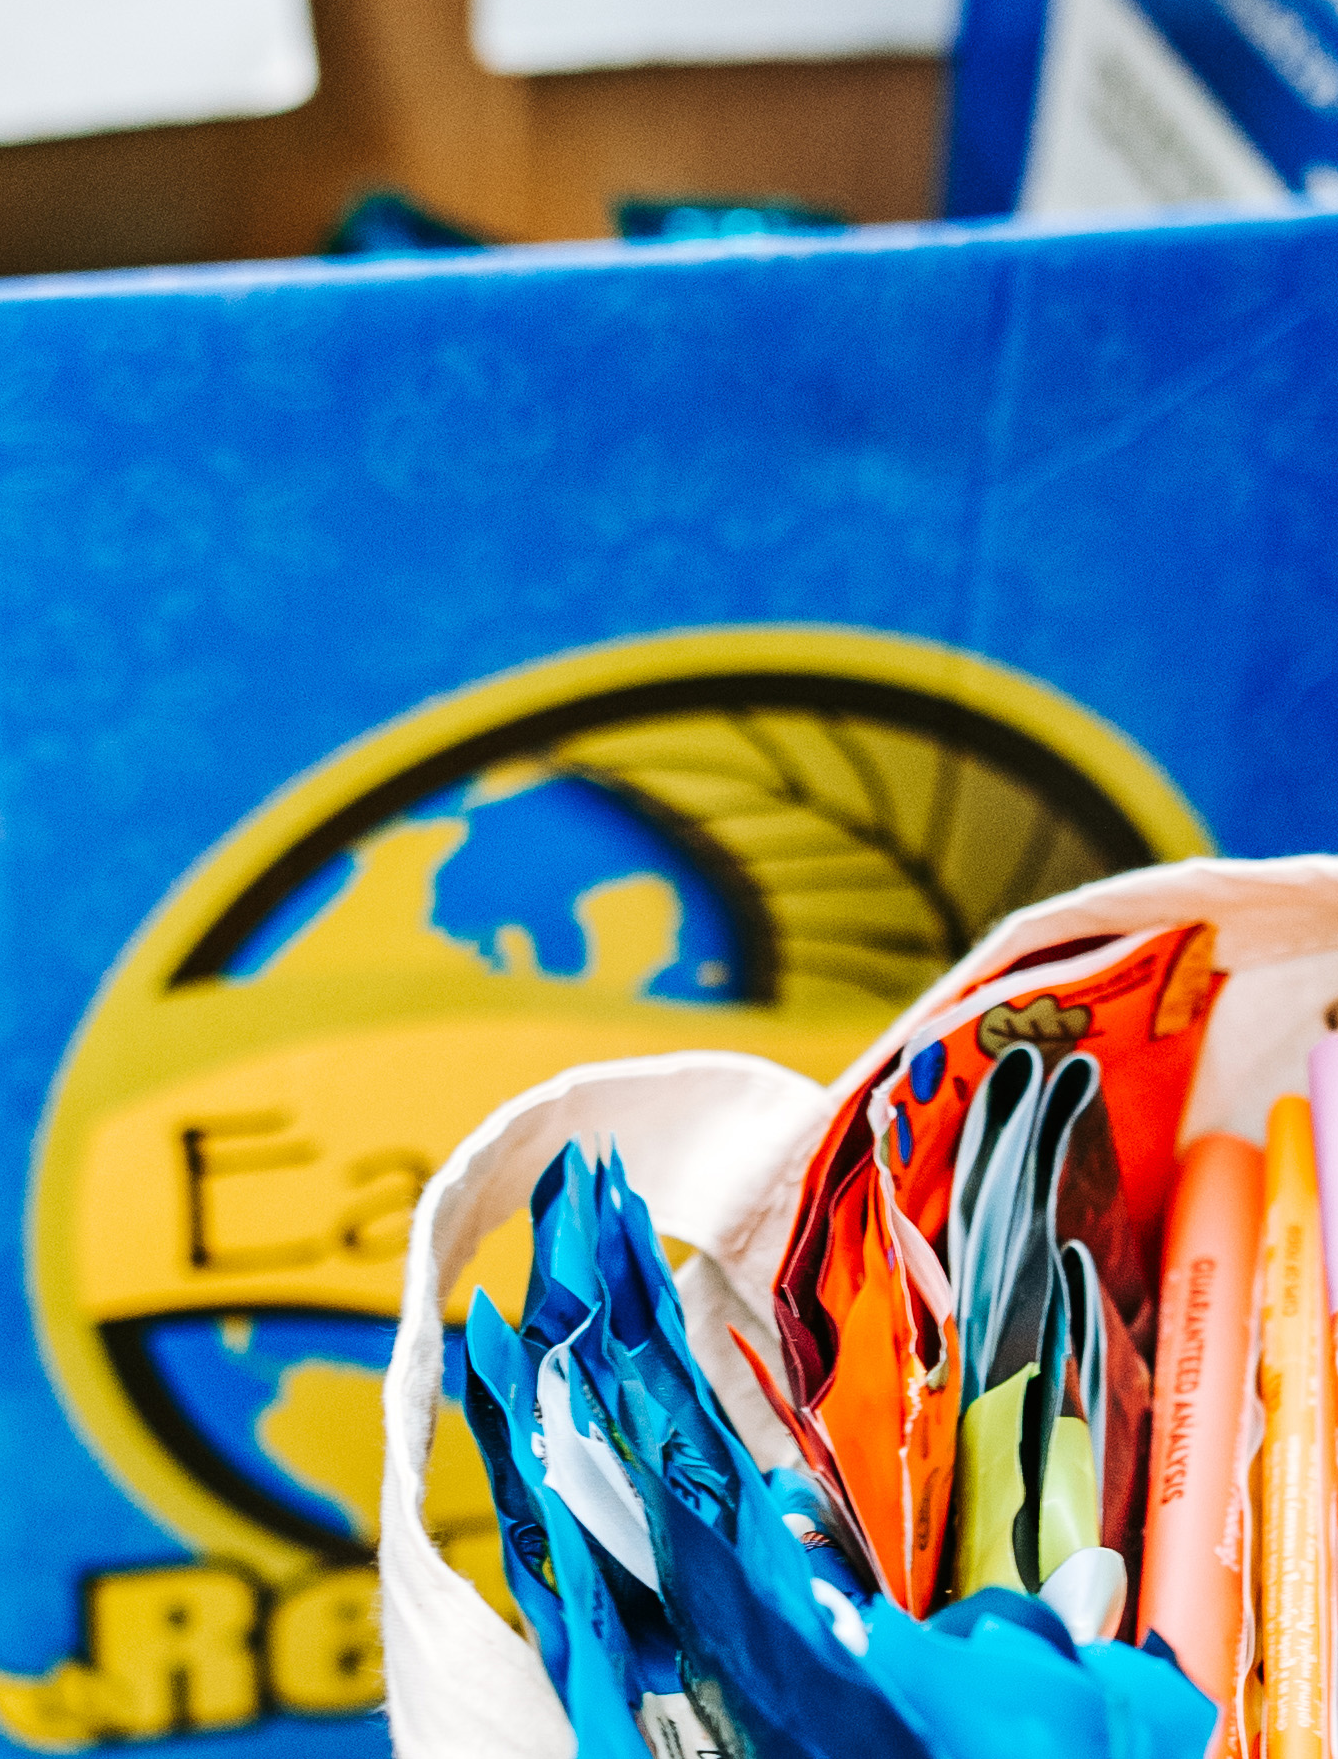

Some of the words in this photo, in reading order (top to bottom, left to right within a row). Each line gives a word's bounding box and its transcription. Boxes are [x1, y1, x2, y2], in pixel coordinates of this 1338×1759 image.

[178, 1107, 433, 1272] Ea
[1174, 1257, 1218, 1395] GUARANTEED
[1159, 1402, 1196, 1507] ANALYSIS
[85, 1557, 385, 1734] Re
[1293, 1679, 1315, 1728] optimal
